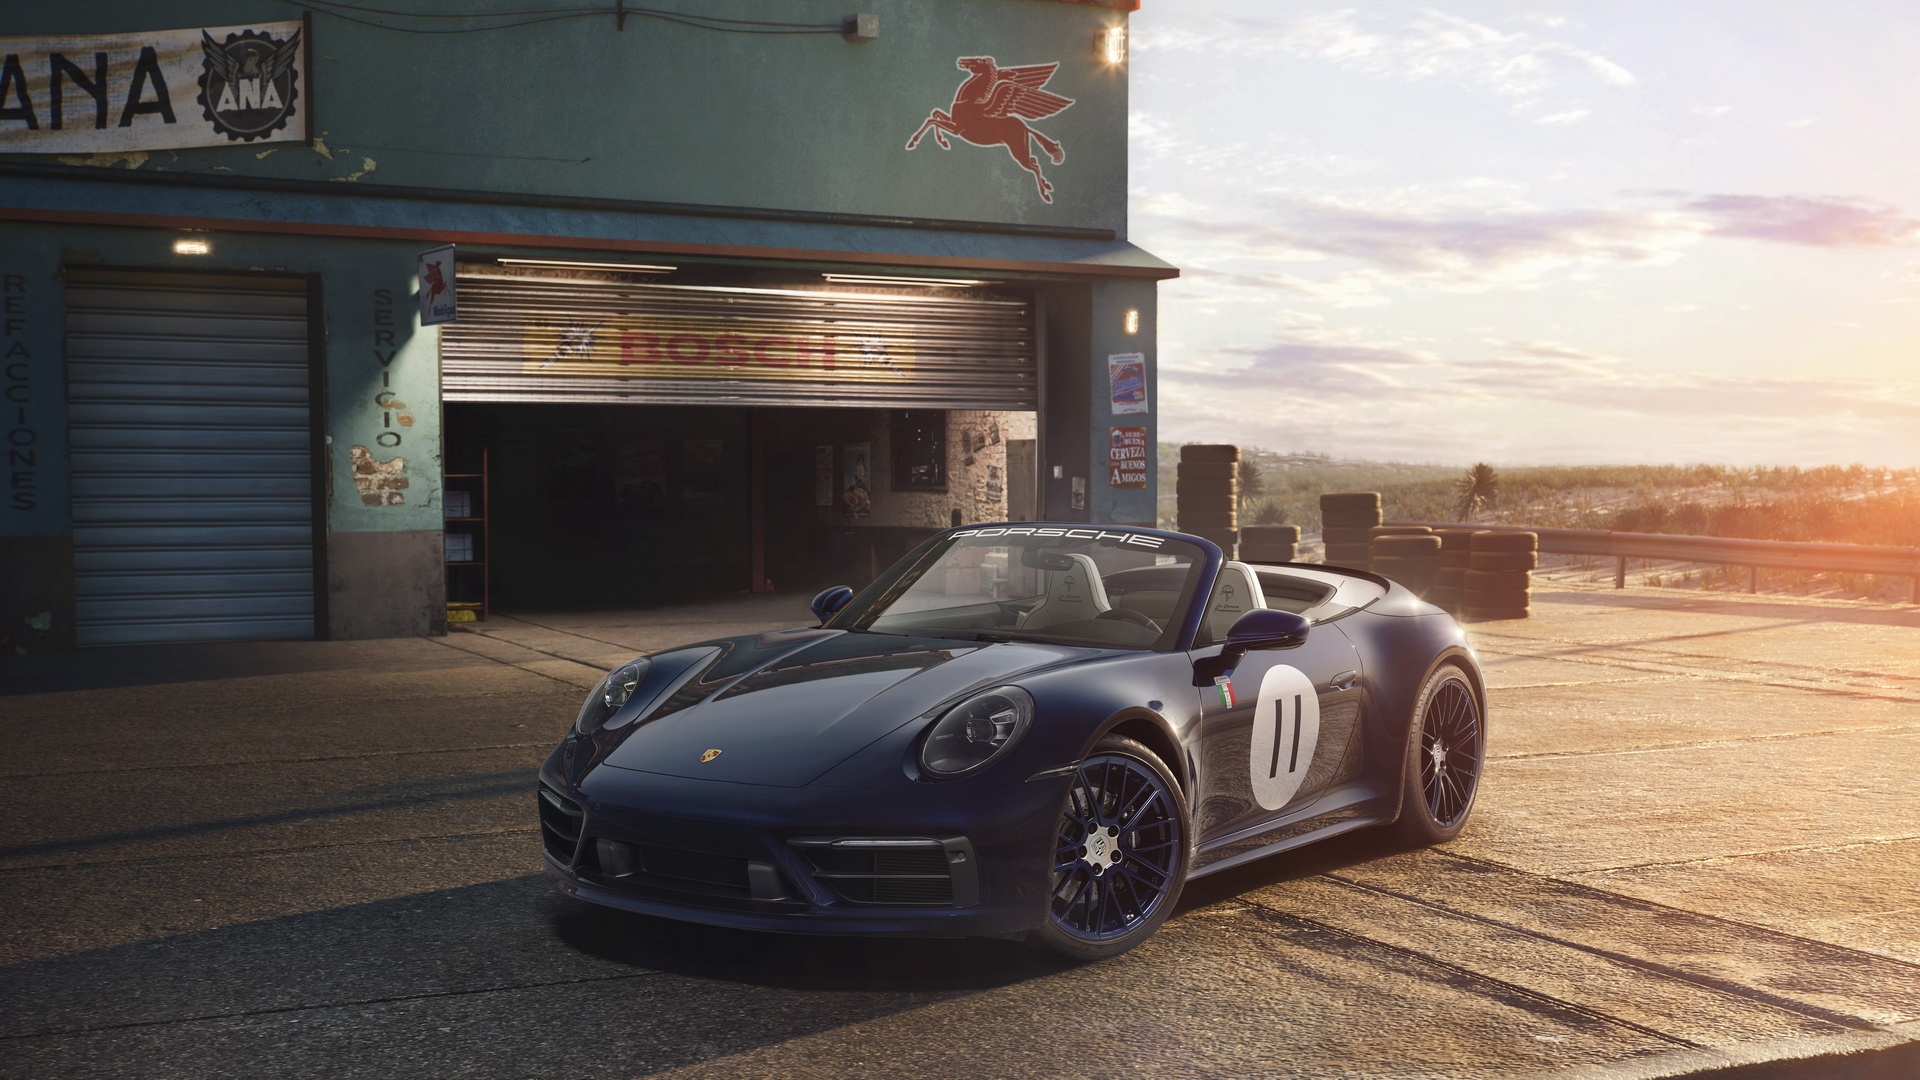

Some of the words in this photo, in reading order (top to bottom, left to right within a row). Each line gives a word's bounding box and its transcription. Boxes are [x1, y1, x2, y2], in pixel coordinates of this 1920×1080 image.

[216, 78, 283, 112] ANA
[620, 330, 836, 369] BOSCH
[373, 288, 402, 448] SERVICIO
[2, 273, 37, 511] REFACCIONES
[1110, 447, 1145, 460] CERVEZA
[1120, 460, 1146, 470] BUENOS
[1110, 468, 1146, 484] AMIGOS
[948, 527, 1165, 549] PORSCHE
[1268, 694, 1302, 779] 11
